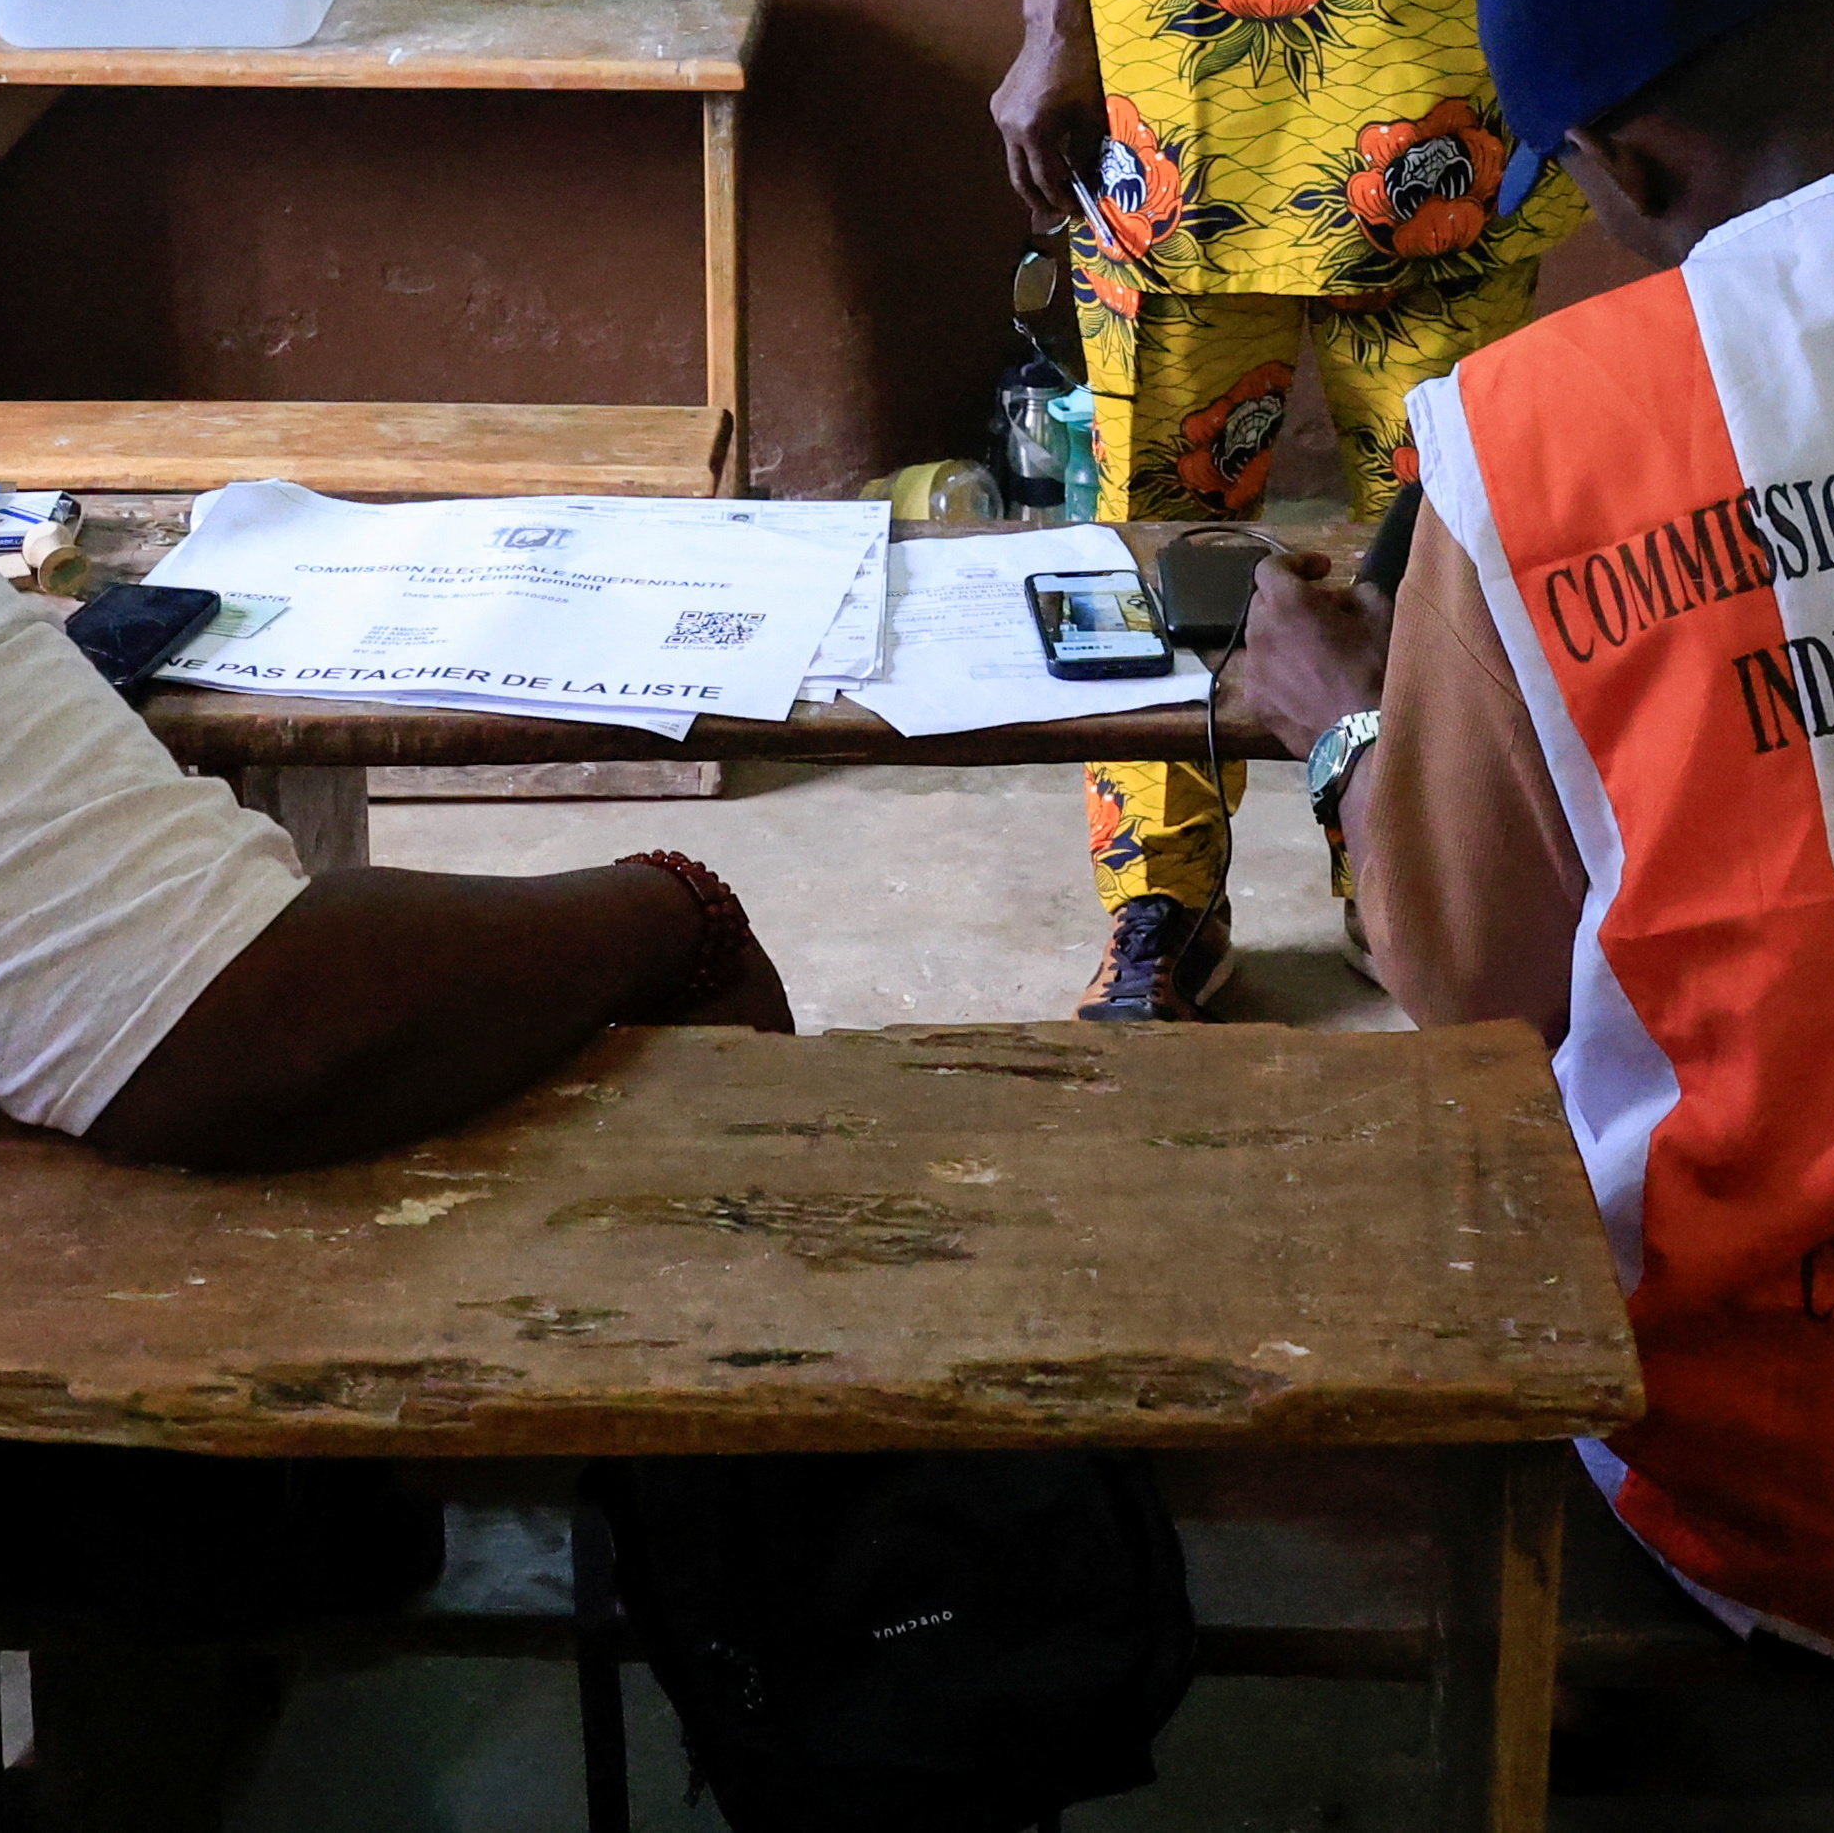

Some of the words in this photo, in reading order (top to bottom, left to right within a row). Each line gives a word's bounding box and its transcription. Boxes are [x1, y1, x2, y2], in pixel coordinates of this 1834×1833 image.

[295, 564, 426, 574] COMMISSION
[430, 564, 566, 577] ELECTORALE
[571, 573, 734, 589] INDEPENDANTE
[408, 574, 455, 584] Liste
[215, 663, 288, 679] PAS
[295, 666, 493, 684] DETACHER
[499, 674, 553, 690] DE
[561, 680, 608, 694] LA
[618, 683, 724, 700] LISTE
[871, 1610, 954, 1640] QUECHUA
